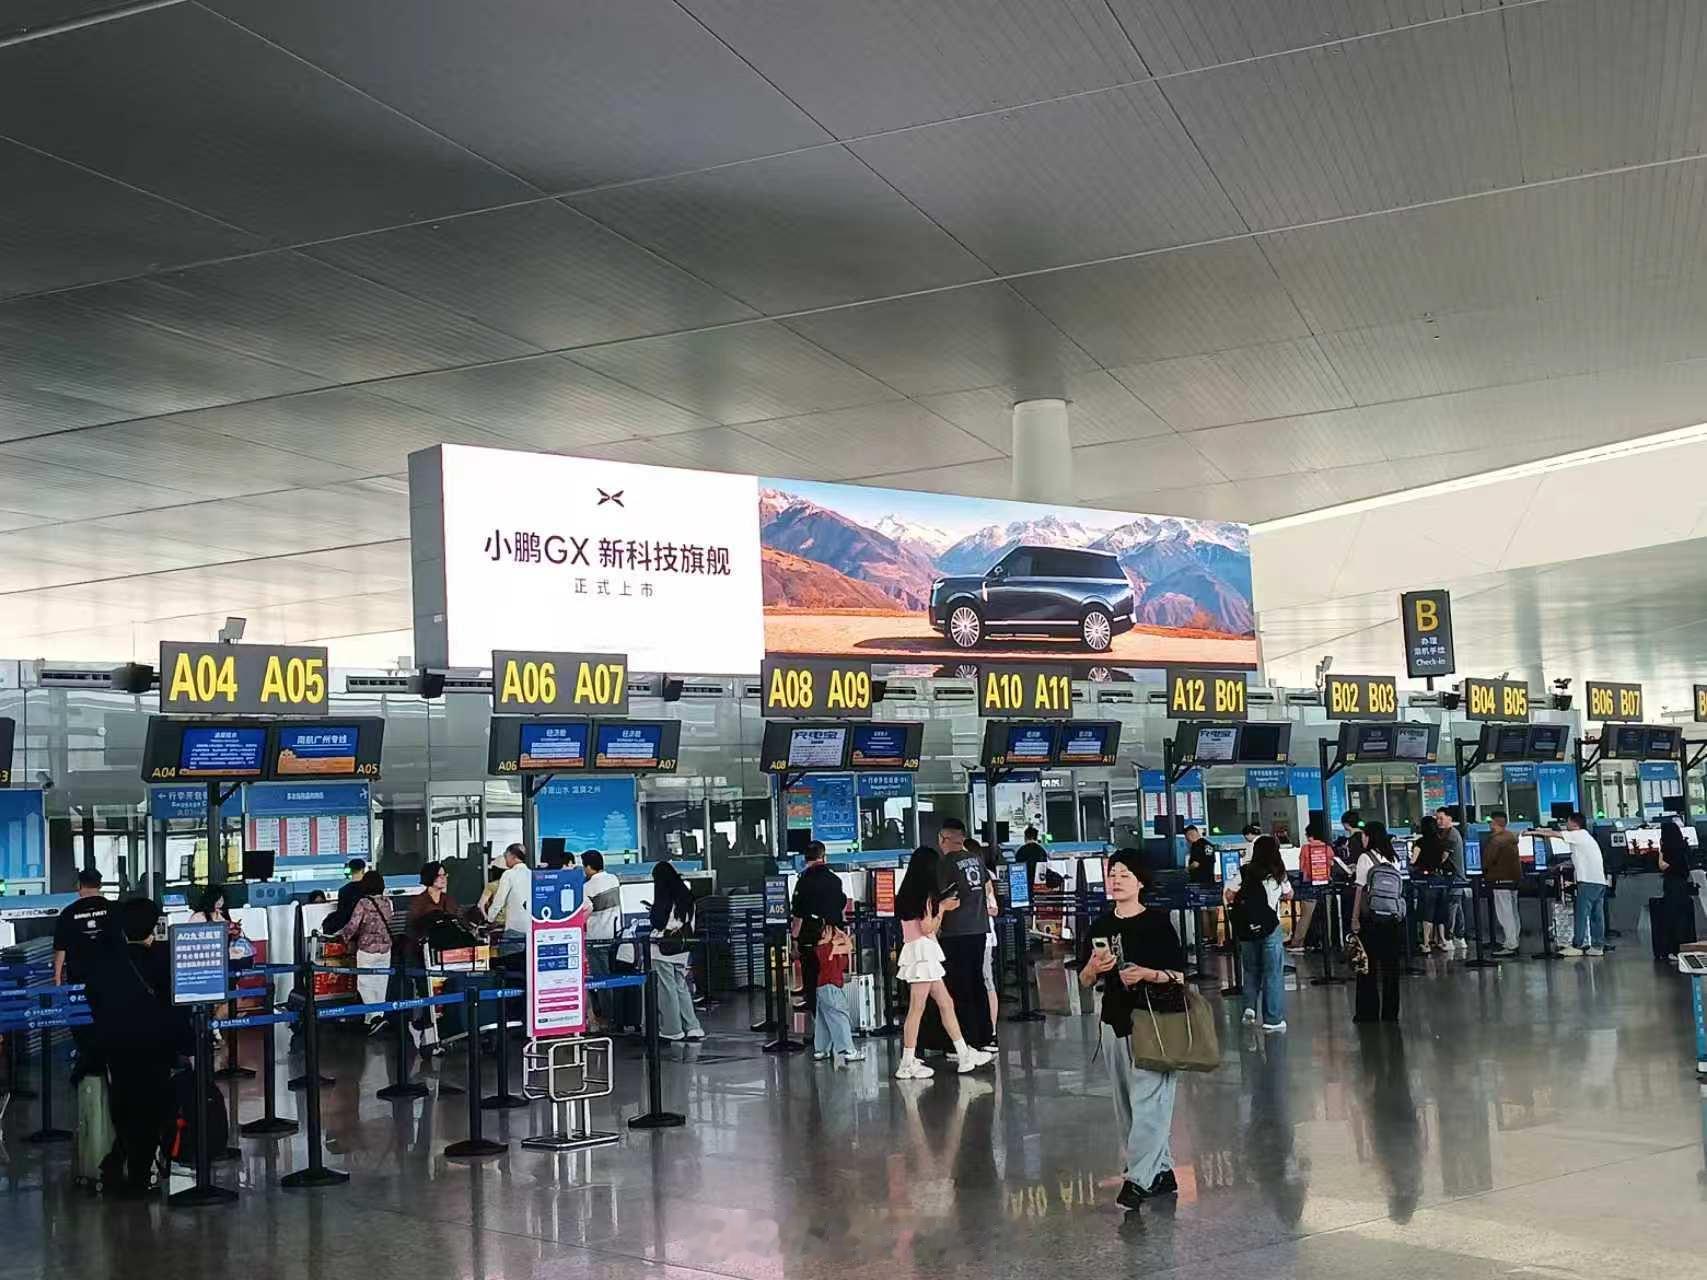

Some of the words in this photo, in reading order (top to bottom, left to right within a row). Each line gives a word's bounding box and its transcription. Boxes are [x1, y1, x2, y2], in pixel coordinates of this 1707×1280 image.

[485, 528, 590, 567] 小鹏GX
[598, 537, 732, 576] 新科技旗舰
[575, 578, 654, 598] 正式上市
[1415, 599, 1439, 632] B
[169, 652, 238, 703] A04
[260, 655, 325, 704] A05
[501, 660, 557, 704] A06
[574, 662, 624, 705] A07
[768, 668, 814, 709] A08
[827, 670, 870, 709] A09
[985, 672, 1023, 709] A10
[1034, 673, 1070, 710] A11
[1172, 677, 1206, 712] A12
[1215, 679, 1244, 713] B01
[1331, 681, 1360, 713] B02
[1368, 682, 1396, 713] B03
[1471, 684, 1496, 715] B04
[1503, 686, 1527, 716] B05
[1591, 687, 1613, 716] B06
[1620, 688, 1640, 716] B07
[152, 767, 176, 778] A04
[356, 763, 379, 775] A05
[498, 761, 518, 771] A06
[658, 759, 677, 770] A07
[769, 760, 787, 770] A08
[904, 759, 919, 768] A09
[991, 756, 1005, 765] A10
[768, 904, 785, 914] A05
